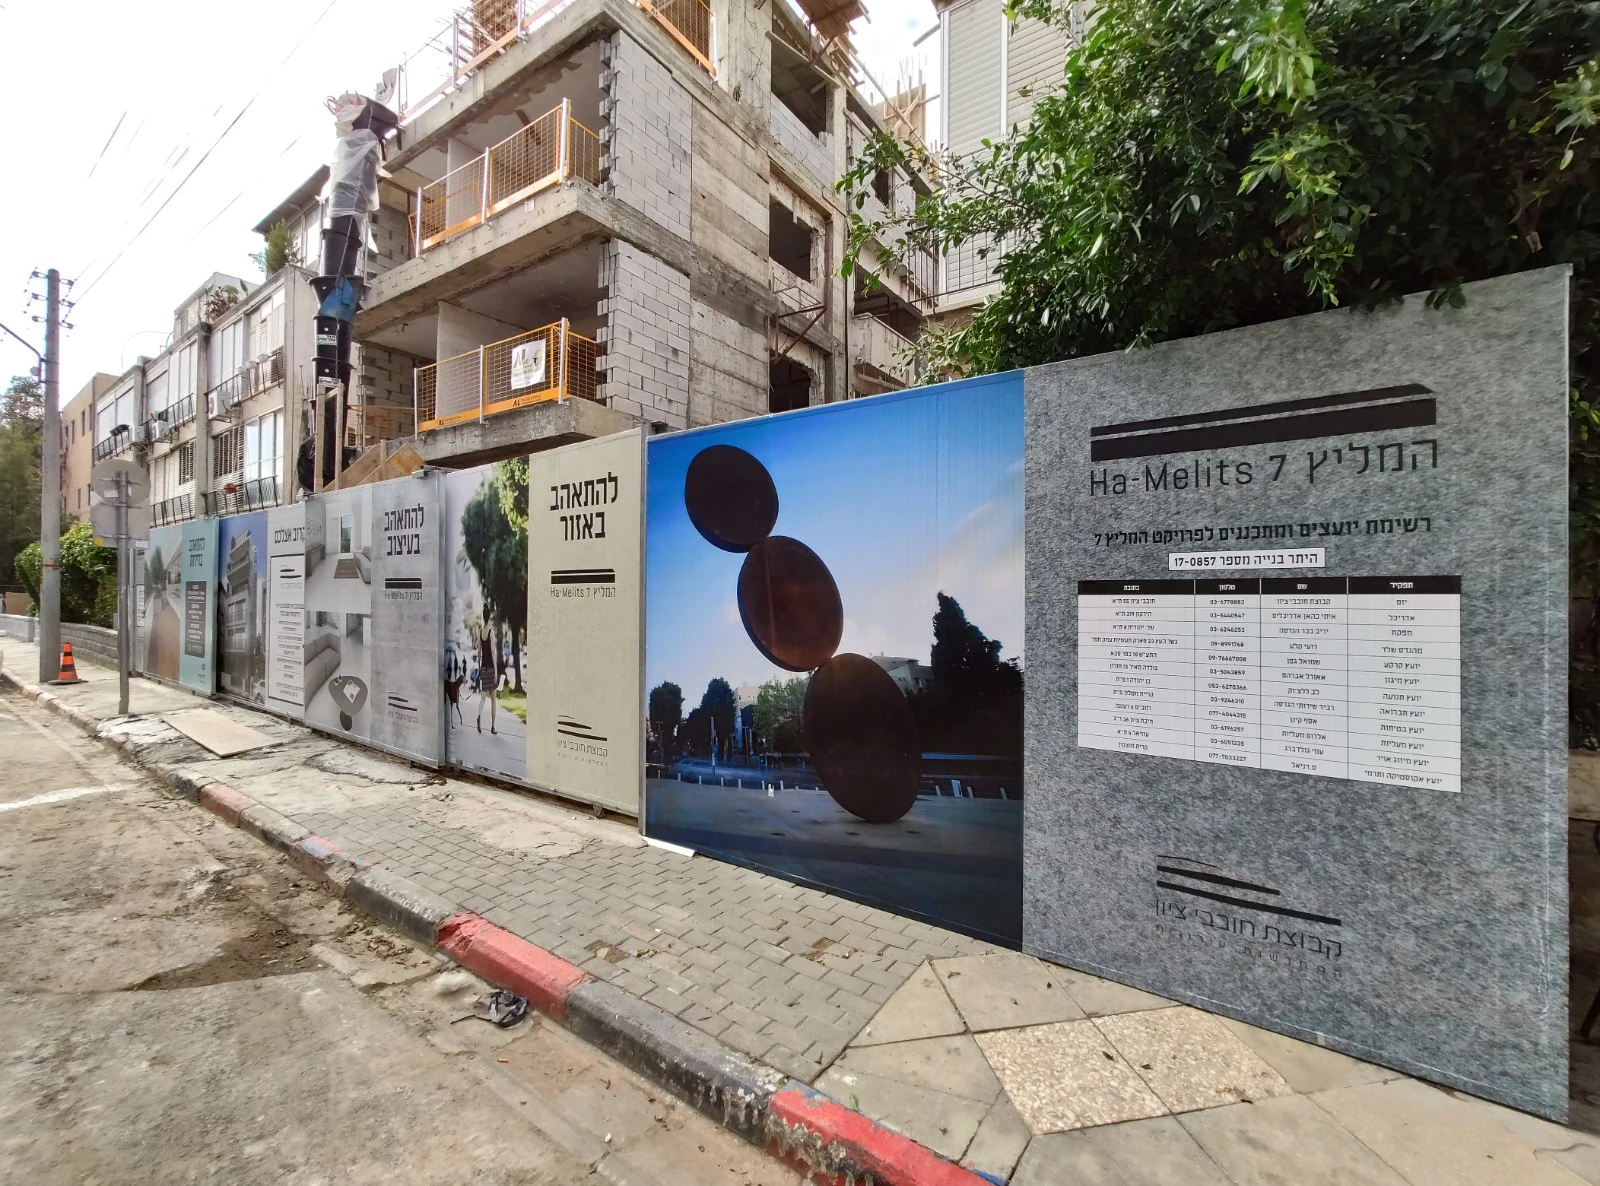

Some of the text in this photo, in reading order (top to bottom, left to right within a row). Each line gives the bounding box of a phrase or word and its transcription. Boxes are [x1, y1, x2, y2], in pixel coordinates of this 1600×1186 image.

[1090, 438, 1438, 497] Ha-Melits 7 המליץ
[550, 472, 618, 511] להתאהב
[384, 503, 424, 531] להתאהב
[560, 512, 606, 541] באזור
[1094, 516, 1431, 547] רשימת יועצים ומתכננים לפרויקט המליץ 7
[387, 534, 420, 556] בעיצוב
[1174, 553, 1318, 567] היתר בנייה מספר 17-0857
[1379, 708, 1407, 716] תברואה
[1380, 724, 1407, 732] בטיחות
[1284, 745, 1309, 753] גולדברג
[1381, 740, 1406, 748] מעליות
[1364, 770, 1384, 778] ותרמי
[1387, 772, 1424, 782] אקוסטיקה
[1155, 899, 1342, 959] קבוצת חובבי ציון
